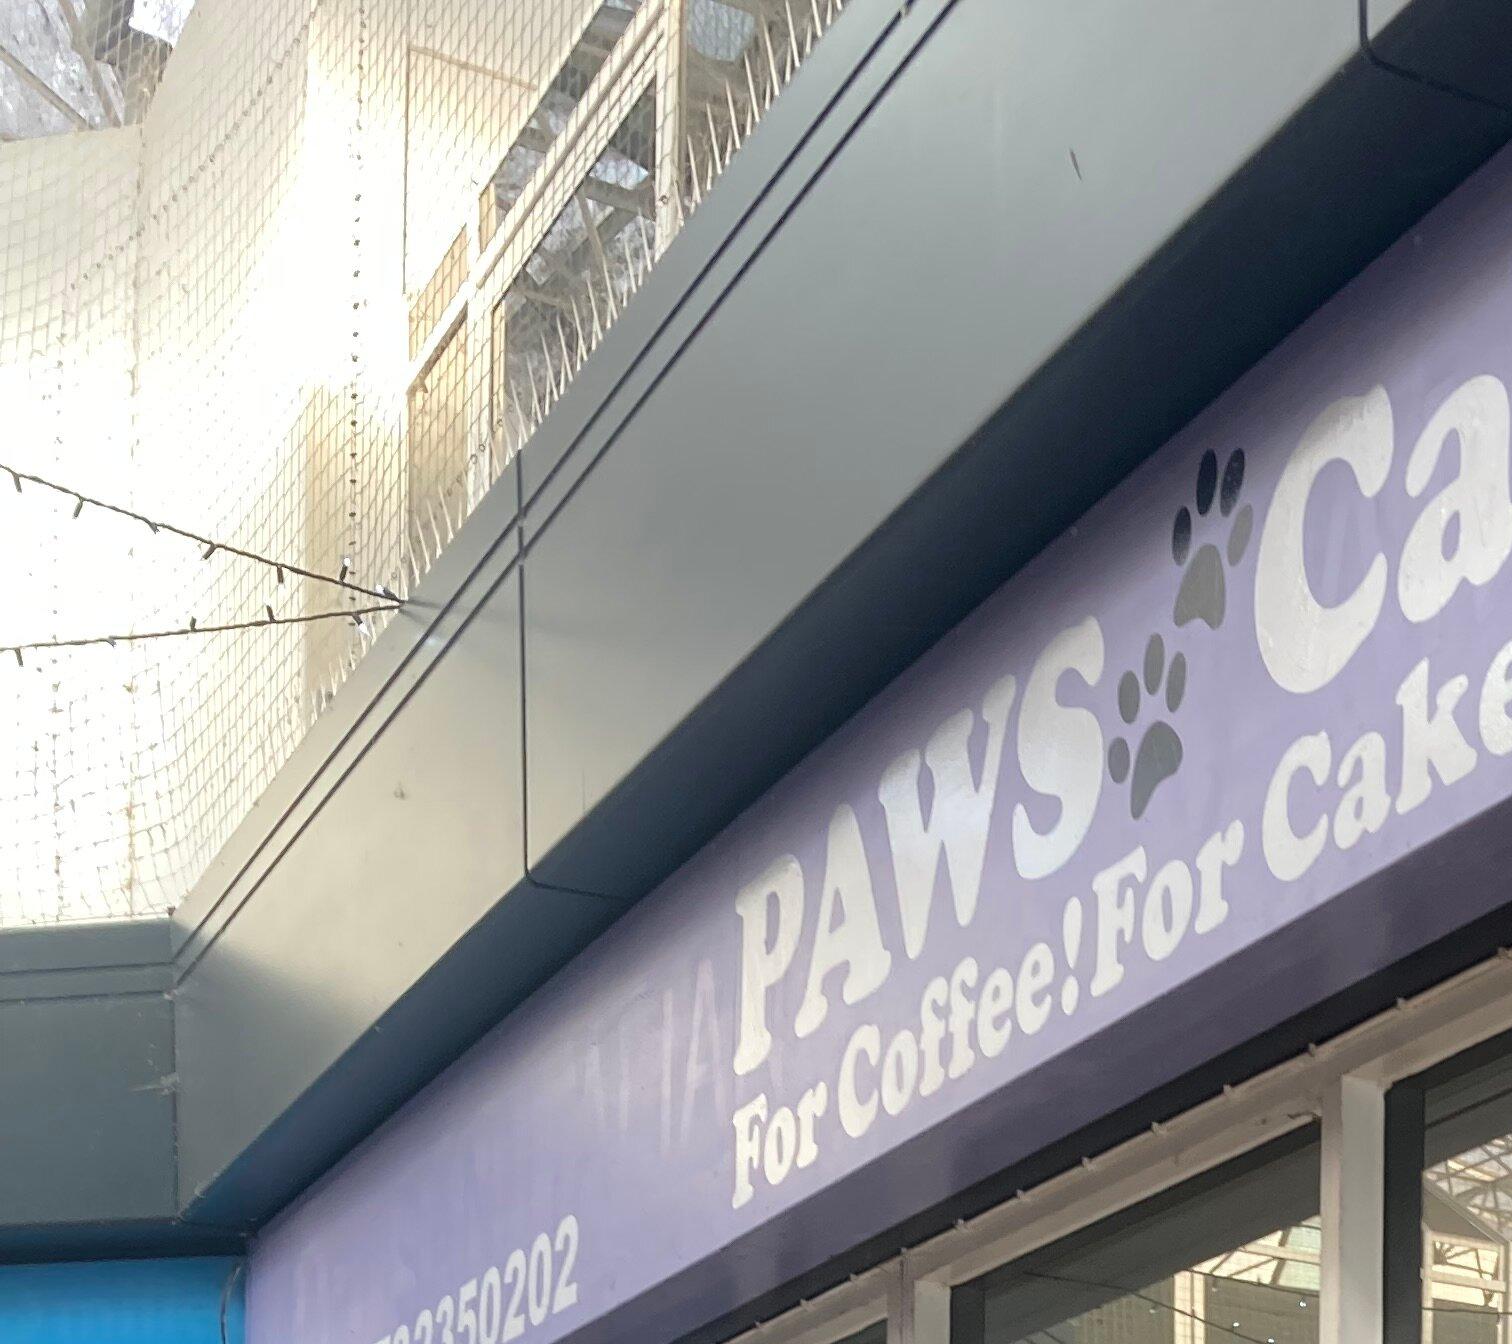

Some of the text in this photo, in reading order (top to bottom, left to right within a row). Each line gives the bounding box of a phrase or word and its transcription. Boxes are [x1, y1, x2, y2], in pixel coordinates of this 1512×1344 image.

[732, 1080, 828, 1210] For
[838, 896, 1083, 1138] Coffee!
[1090, 818, 1243, 998] For
[733, 614, 1105, 1076] PAWS
